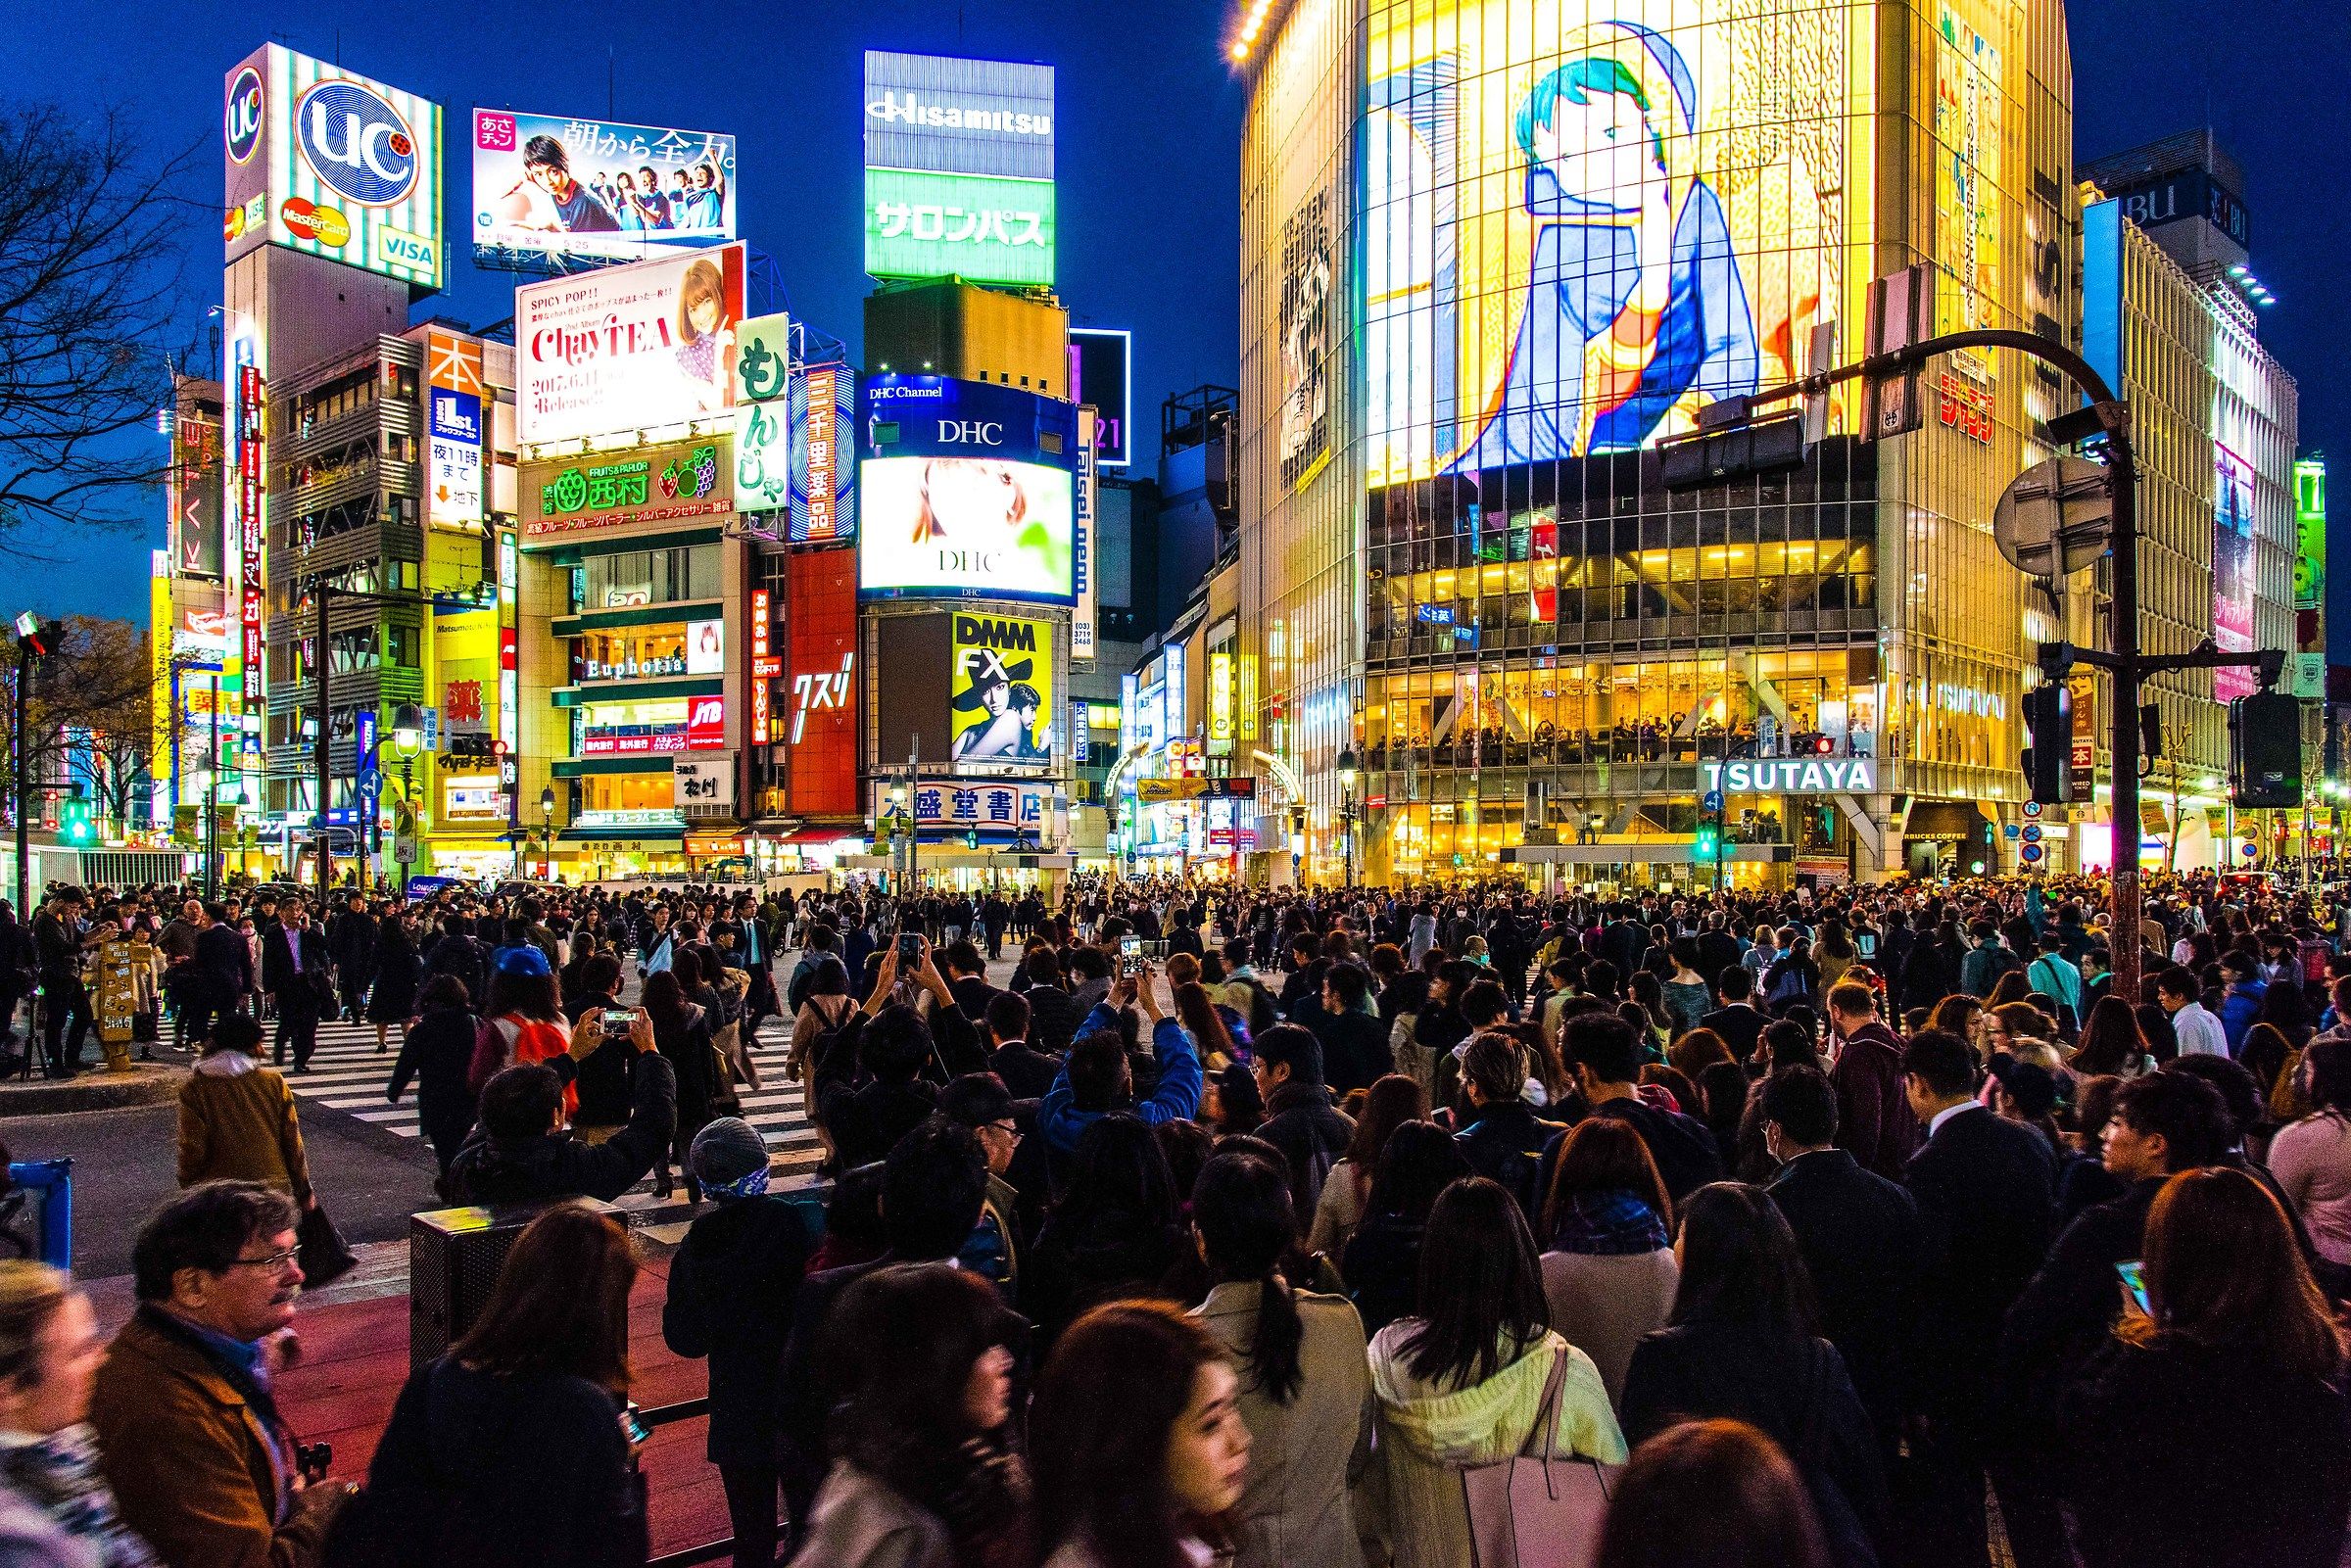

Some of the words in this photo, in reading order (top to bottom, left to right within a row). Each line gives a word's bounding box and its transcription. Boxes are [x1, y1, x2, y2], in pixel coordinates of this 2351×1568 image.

[481, 117, 512, 131] あさ
[866, 91, 1051, 135] Hisamitsu
[481, 132, 511, 147] チャン
[562, 121, 735, 169] 朝から全力。
[283, 207, 350, 237] MasterCard
[875, 201, 1044, 248] サロンパス
[386, 237, 433, 265] VISA
[531, 296, 560, 310] SPICY
[565, 287, 599, 303] POP!!
[870, 388, 894, 400] DHC
[895, 386, 942, 399] Channel
[937, 420, 1003, 446] DHC
[434, 444, 478, 467] 夜11時
[806, 378, 831, 529] 三千里薬品
[590, 474, 648, 509] 西村
[939, 550, 1001, 572] DHC
[957, 617, 1036, 652] DMM
[588, 656, 683, 681] Euphoria
[956, 648, 1010, 682] FX
[792, 652, 854, 744] クスリ
[691, 701, 723, 728] JTB
[2073, 748, 2089, 764] 本
[1703, 761, 1872, 792] TSUTAYA
[884, 788, 1041, 823] 大盛堂書店
